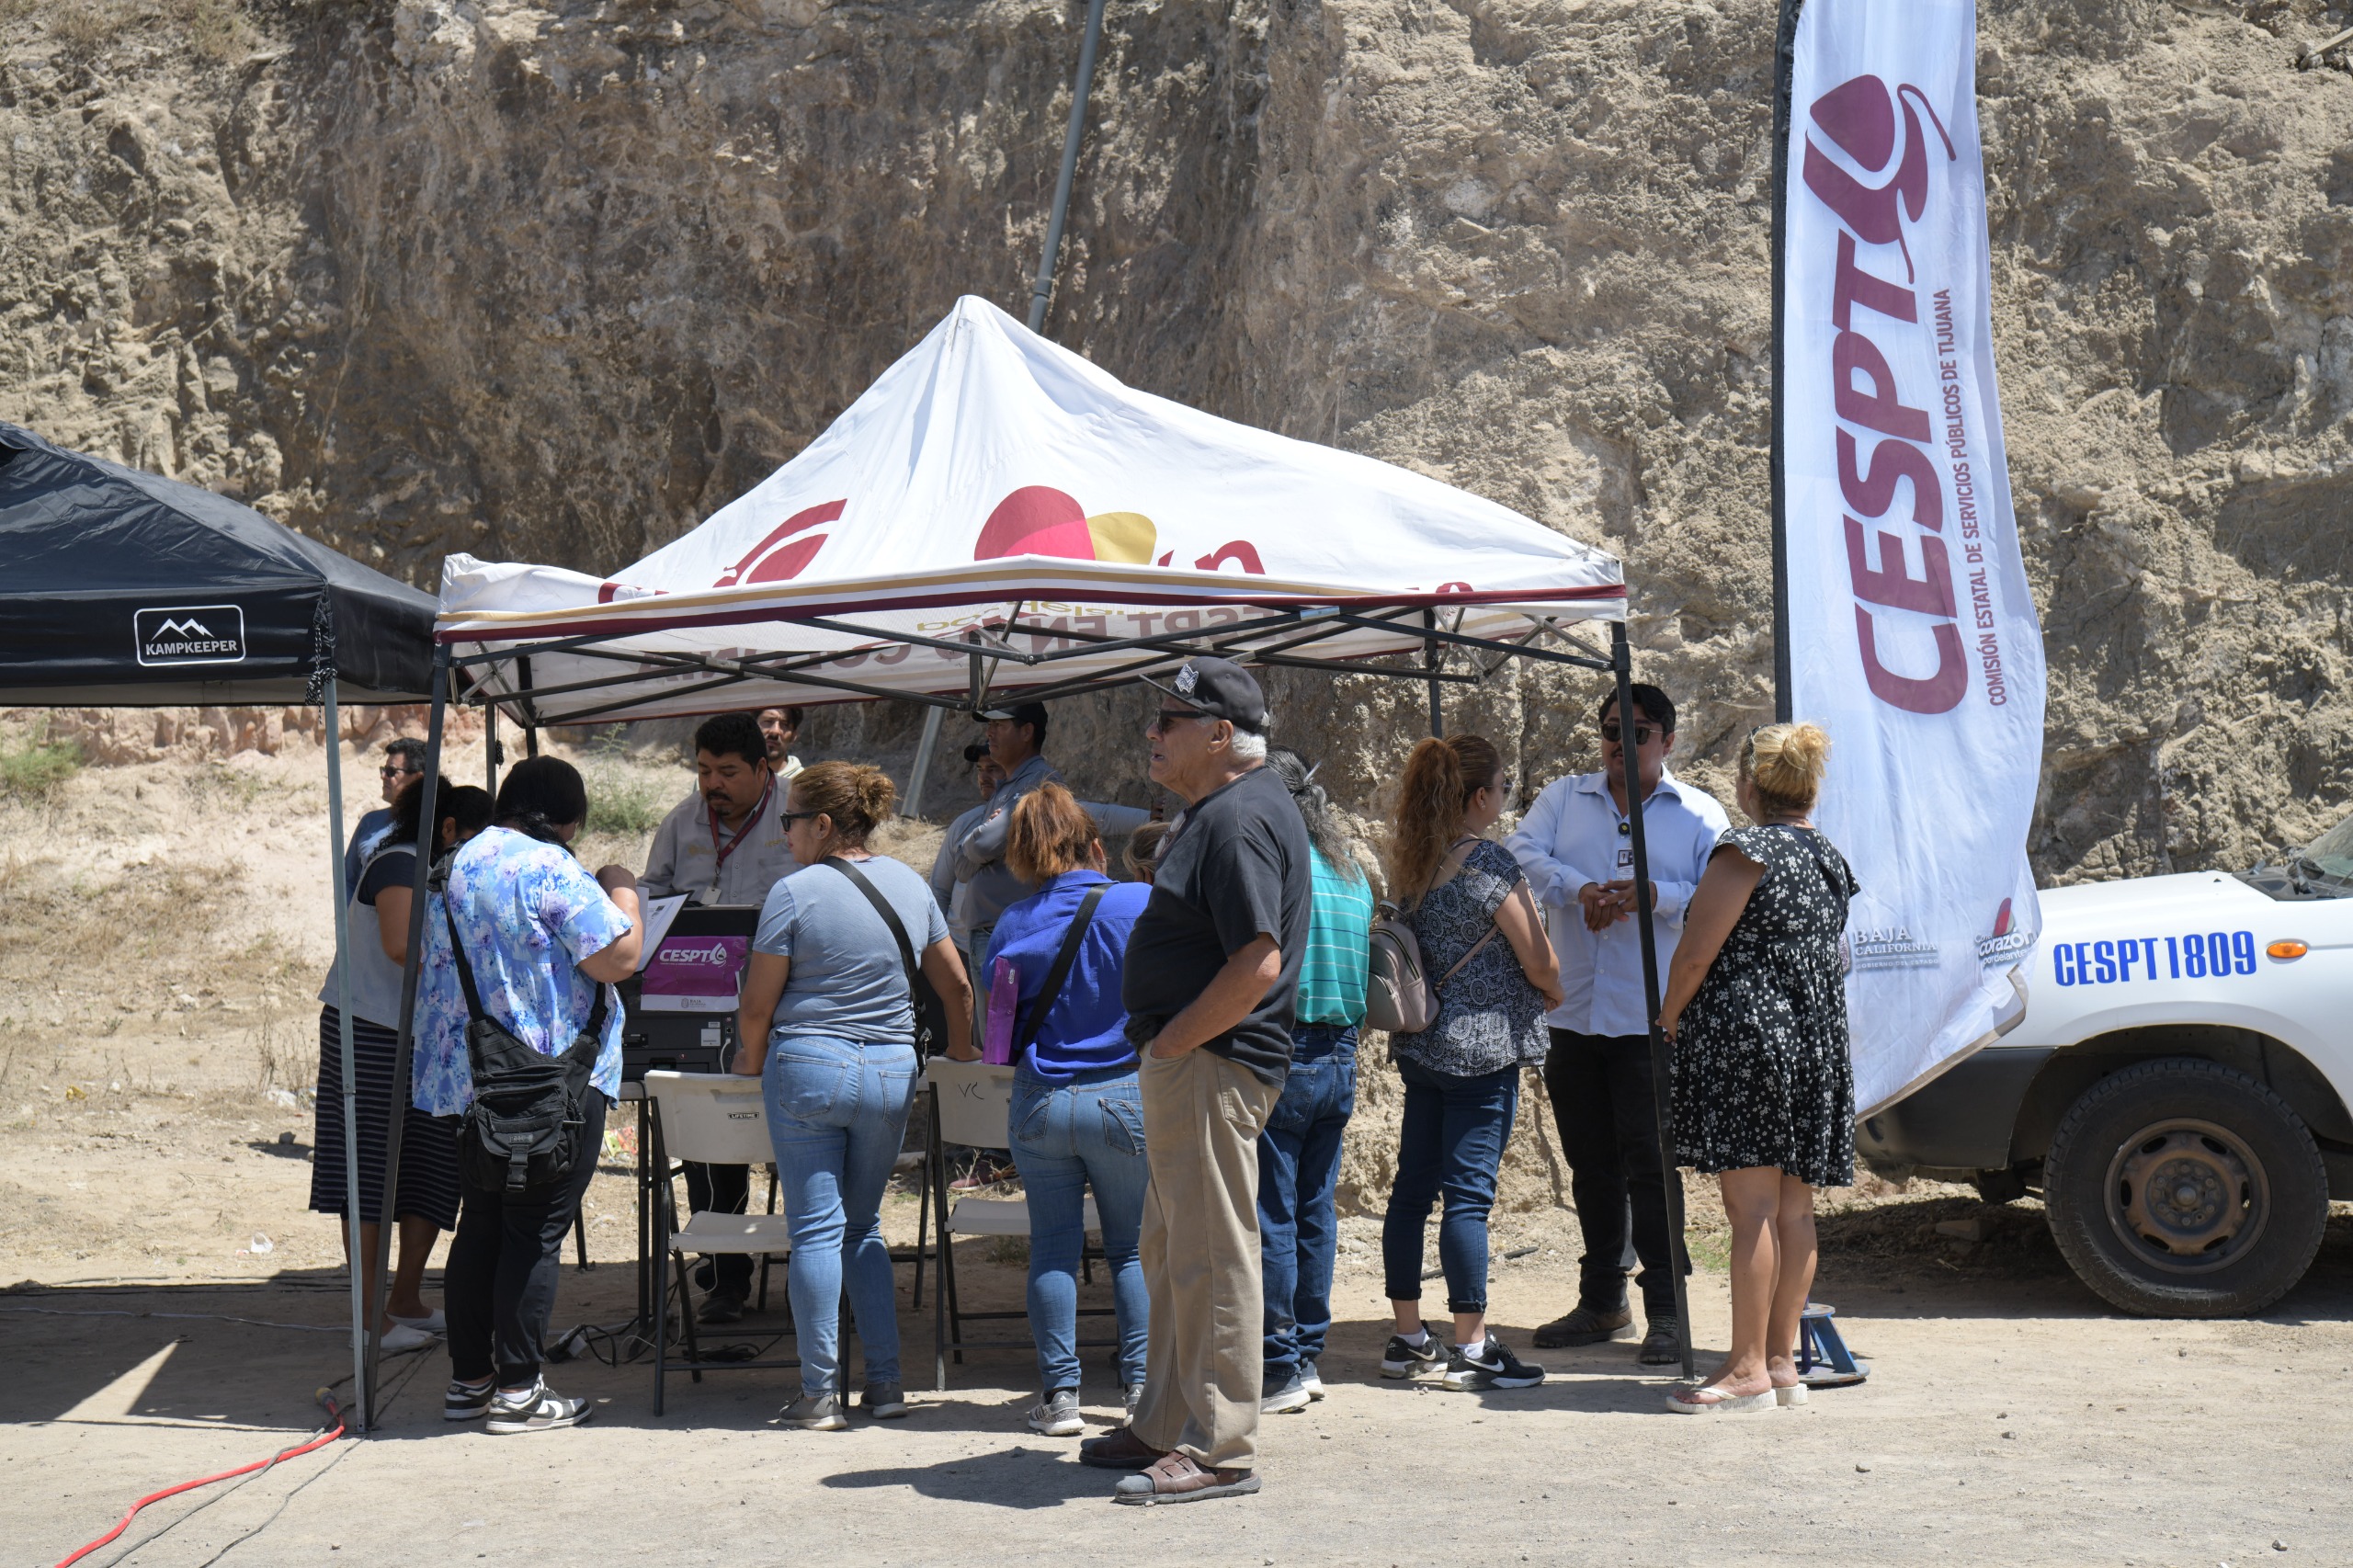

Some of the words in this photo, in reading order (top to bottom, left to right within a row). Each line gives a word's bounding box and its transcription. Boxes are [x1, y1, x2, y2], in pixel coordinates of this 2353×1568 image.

[1933, 289, 1955, 356] TIJUANA
[1940, 359, 1958, 381] DE
[1943, 384, 1968, 459] PÚBLICOS
[1832, 228, 1969, 714] CESPT
[1953, 462, 1980, 540] SERVICIOS
[1965, 542, 1984, 563] DE
[1969, 566, 1995, 630] ESTATAL
[145, 640, 237, 655] KAMPKEEPER
[1976, 631, 2007, 707] COMISIÓN
[1855, 925, 1912, 944] BAJA
[1979, 927, 2038, 956] corazón
[659, 949, 711, 962] CESPT
[1855, 941, 1938, 956] CALIFORNIA
[1995, 949, 2027, 961] delante
[2053, 937, 2158, 987] CESPT
[2164, 930, 2257, 979] 1809
[1857, 961, 1893, 970] GOBIERNO
